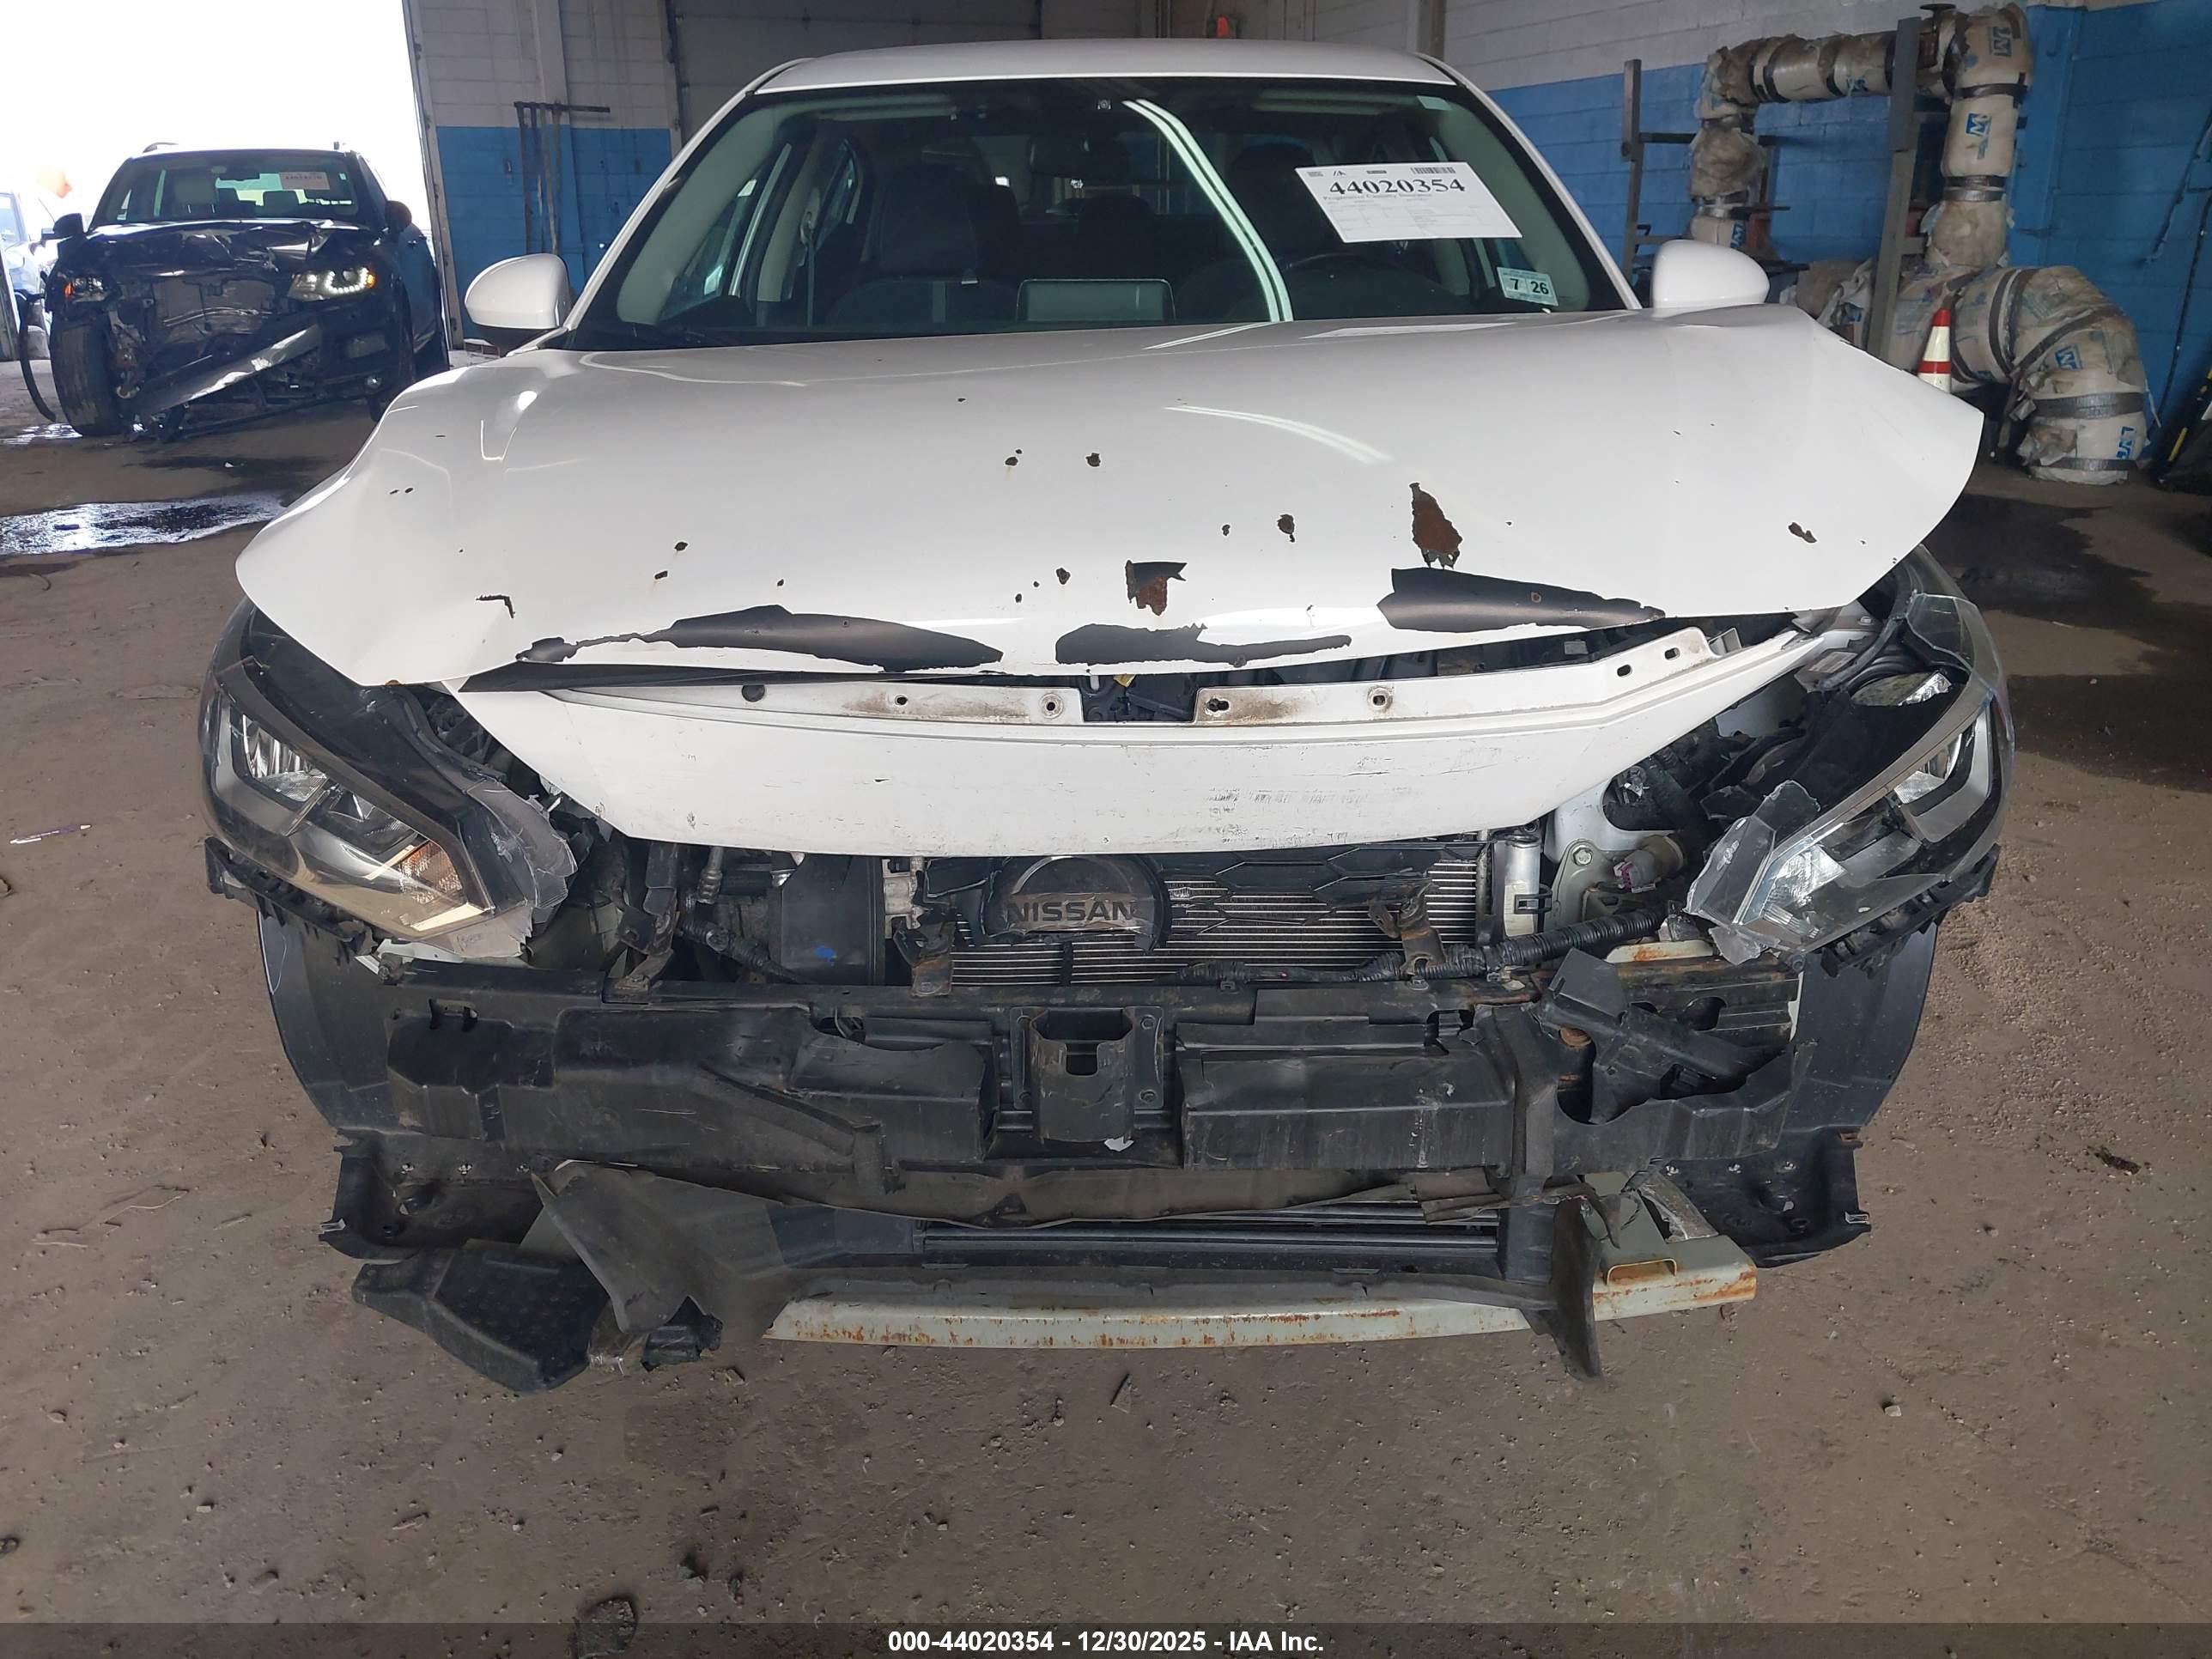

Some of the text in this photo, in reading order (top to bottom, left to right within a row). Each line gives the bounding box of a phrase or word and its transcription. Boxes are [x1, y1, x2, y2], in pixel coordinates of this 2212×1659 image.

[1330, 179, 1465, 195] 44020354
[1510, 277, 1549, 295] 7 26
[1007, 902, 1134, 921] NISSAN
